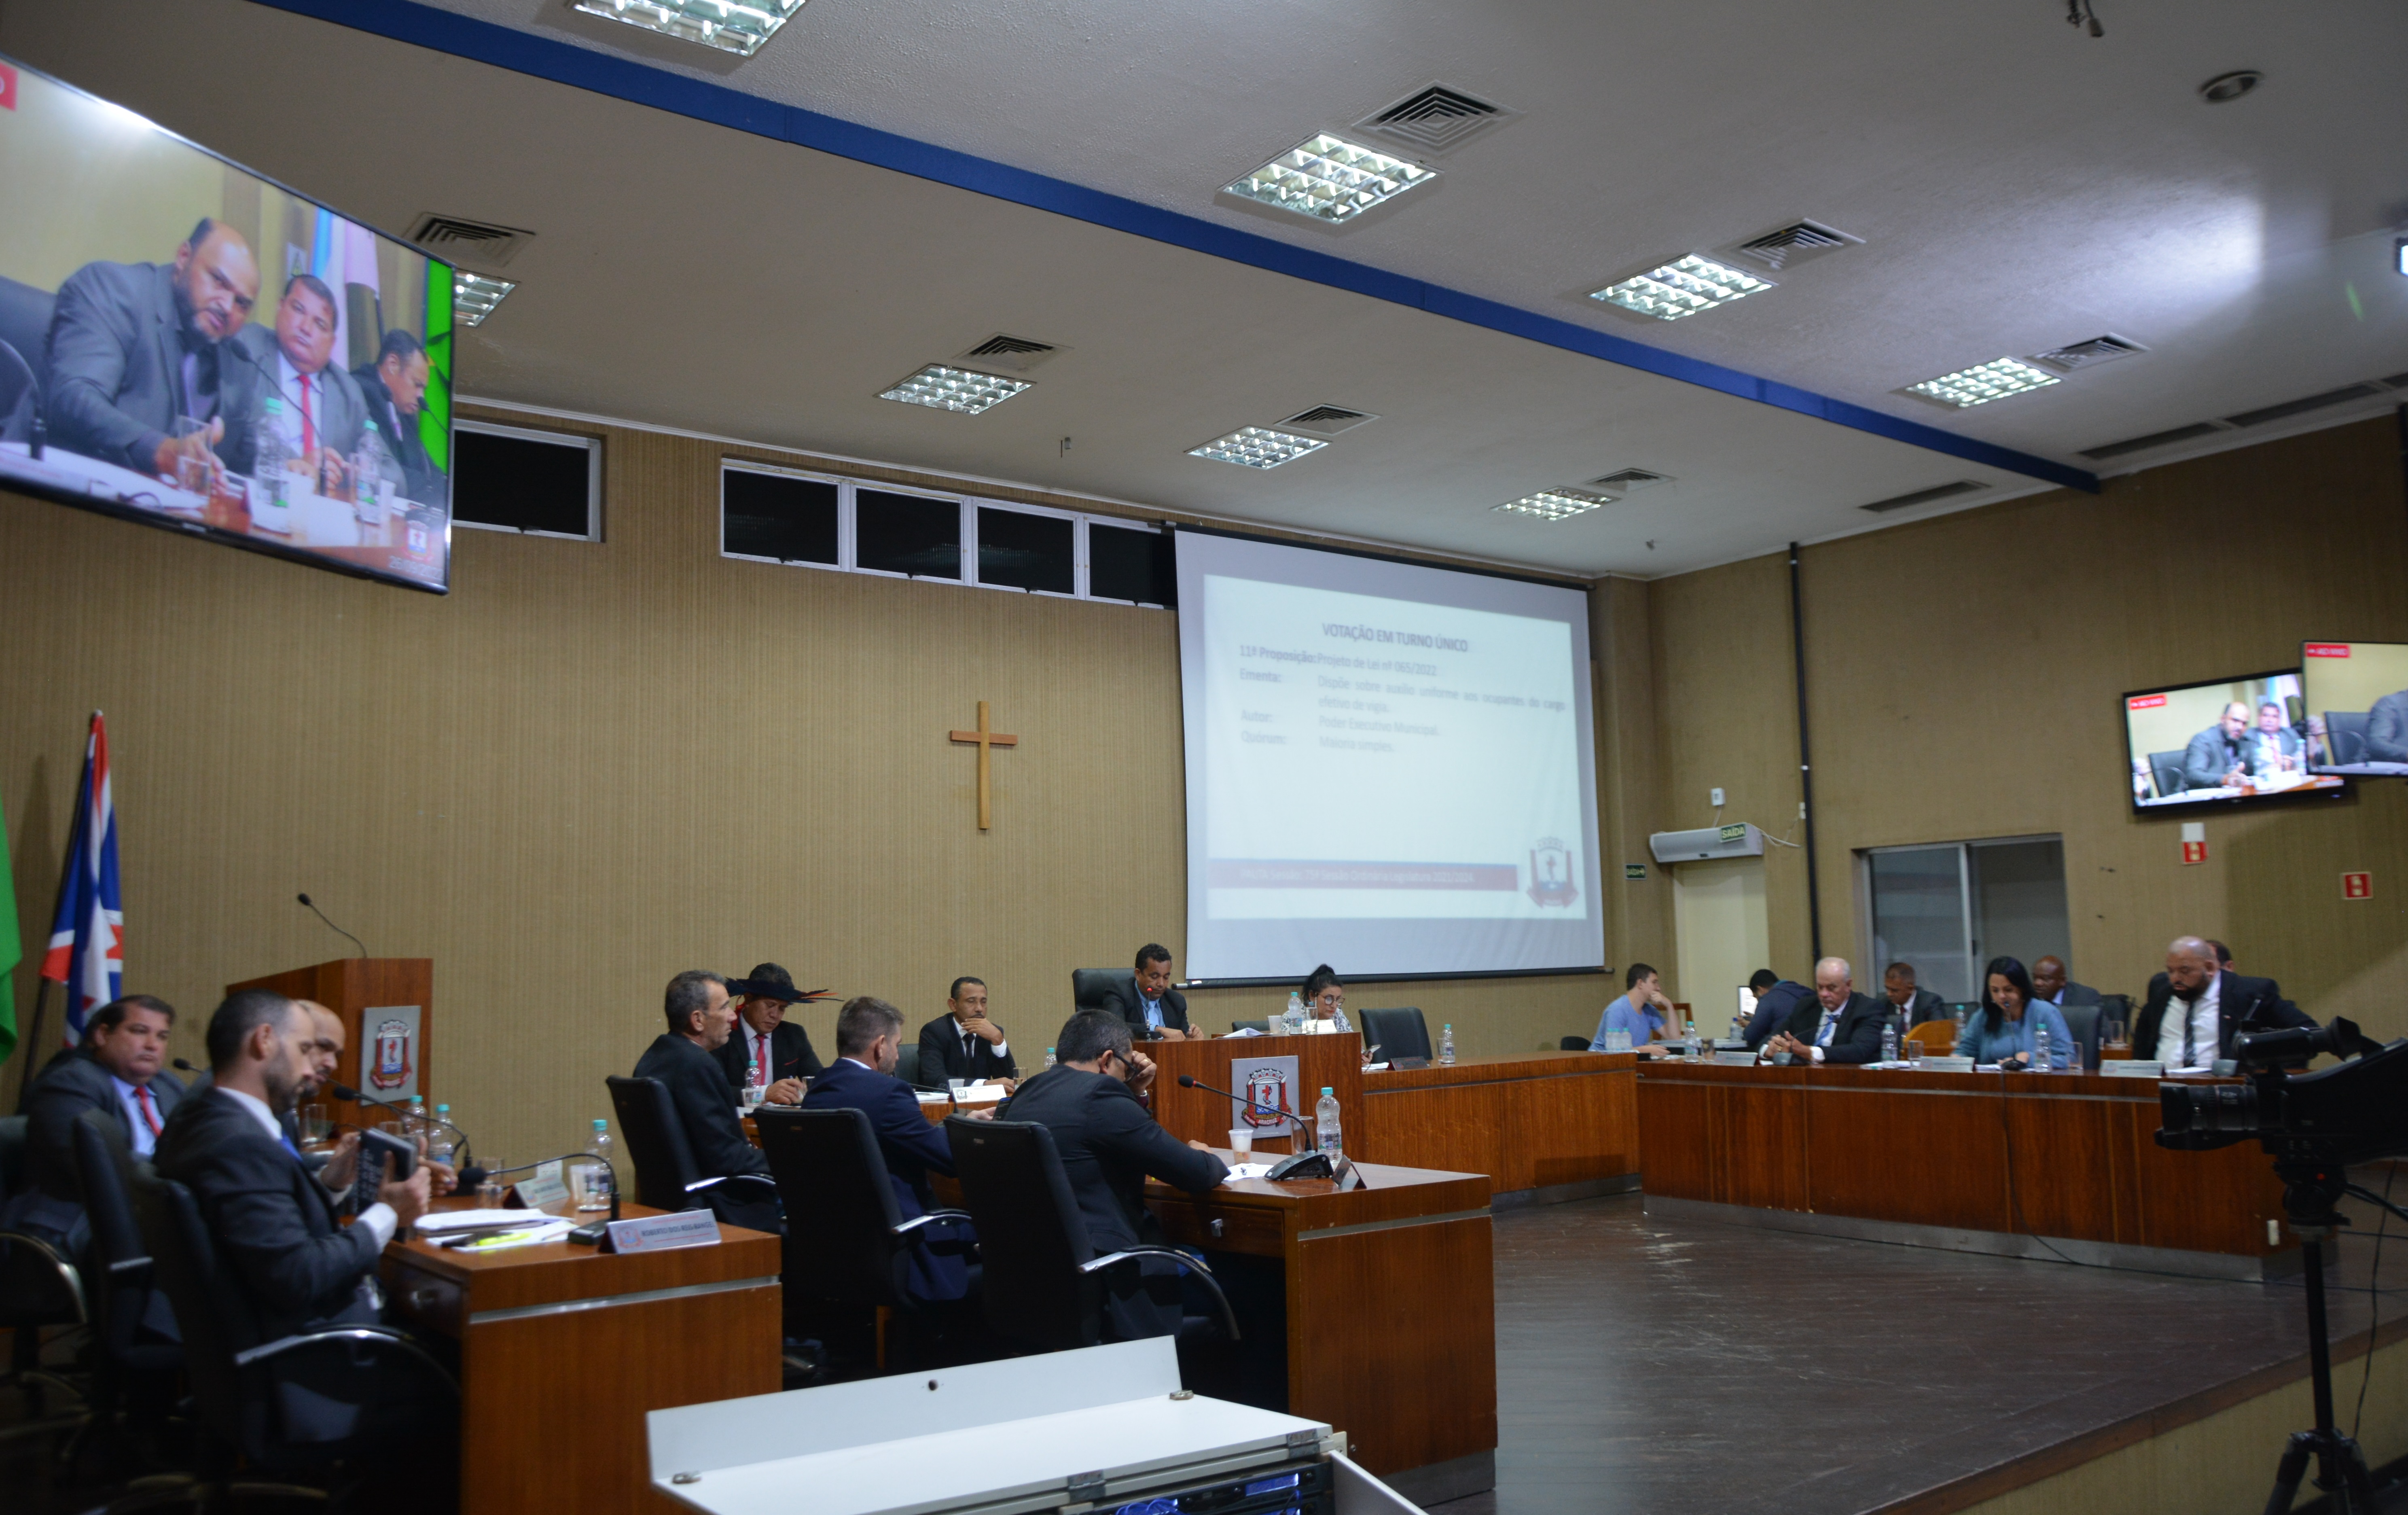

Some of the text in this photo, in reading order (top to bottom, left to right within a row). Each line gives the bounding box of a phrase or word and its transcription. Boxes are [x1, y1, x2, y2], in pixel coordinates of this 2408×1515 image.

[1322, 623, 1469, 652] VOTAÇÃO EM TURNO ÚNICO
[1317, 653, 1351, 668] Projeto
[1353, 657, 1365, 669] de
[1367, 658, 1380, 670] Lei
[1239, 668, 1281, 682] Ementa:
[1318, 675, 1350, 690] Dispõe
[1355, 680, 1381, 692] sobre
[1463, 692, 1478, 702] aos
[1352, 699, 1364, 710] de
[1241, 709, 1273, 723] Autor:
[1319, 715, 1347, 729] Poder
[1722, 826, 1745, 839] SAÍDA
